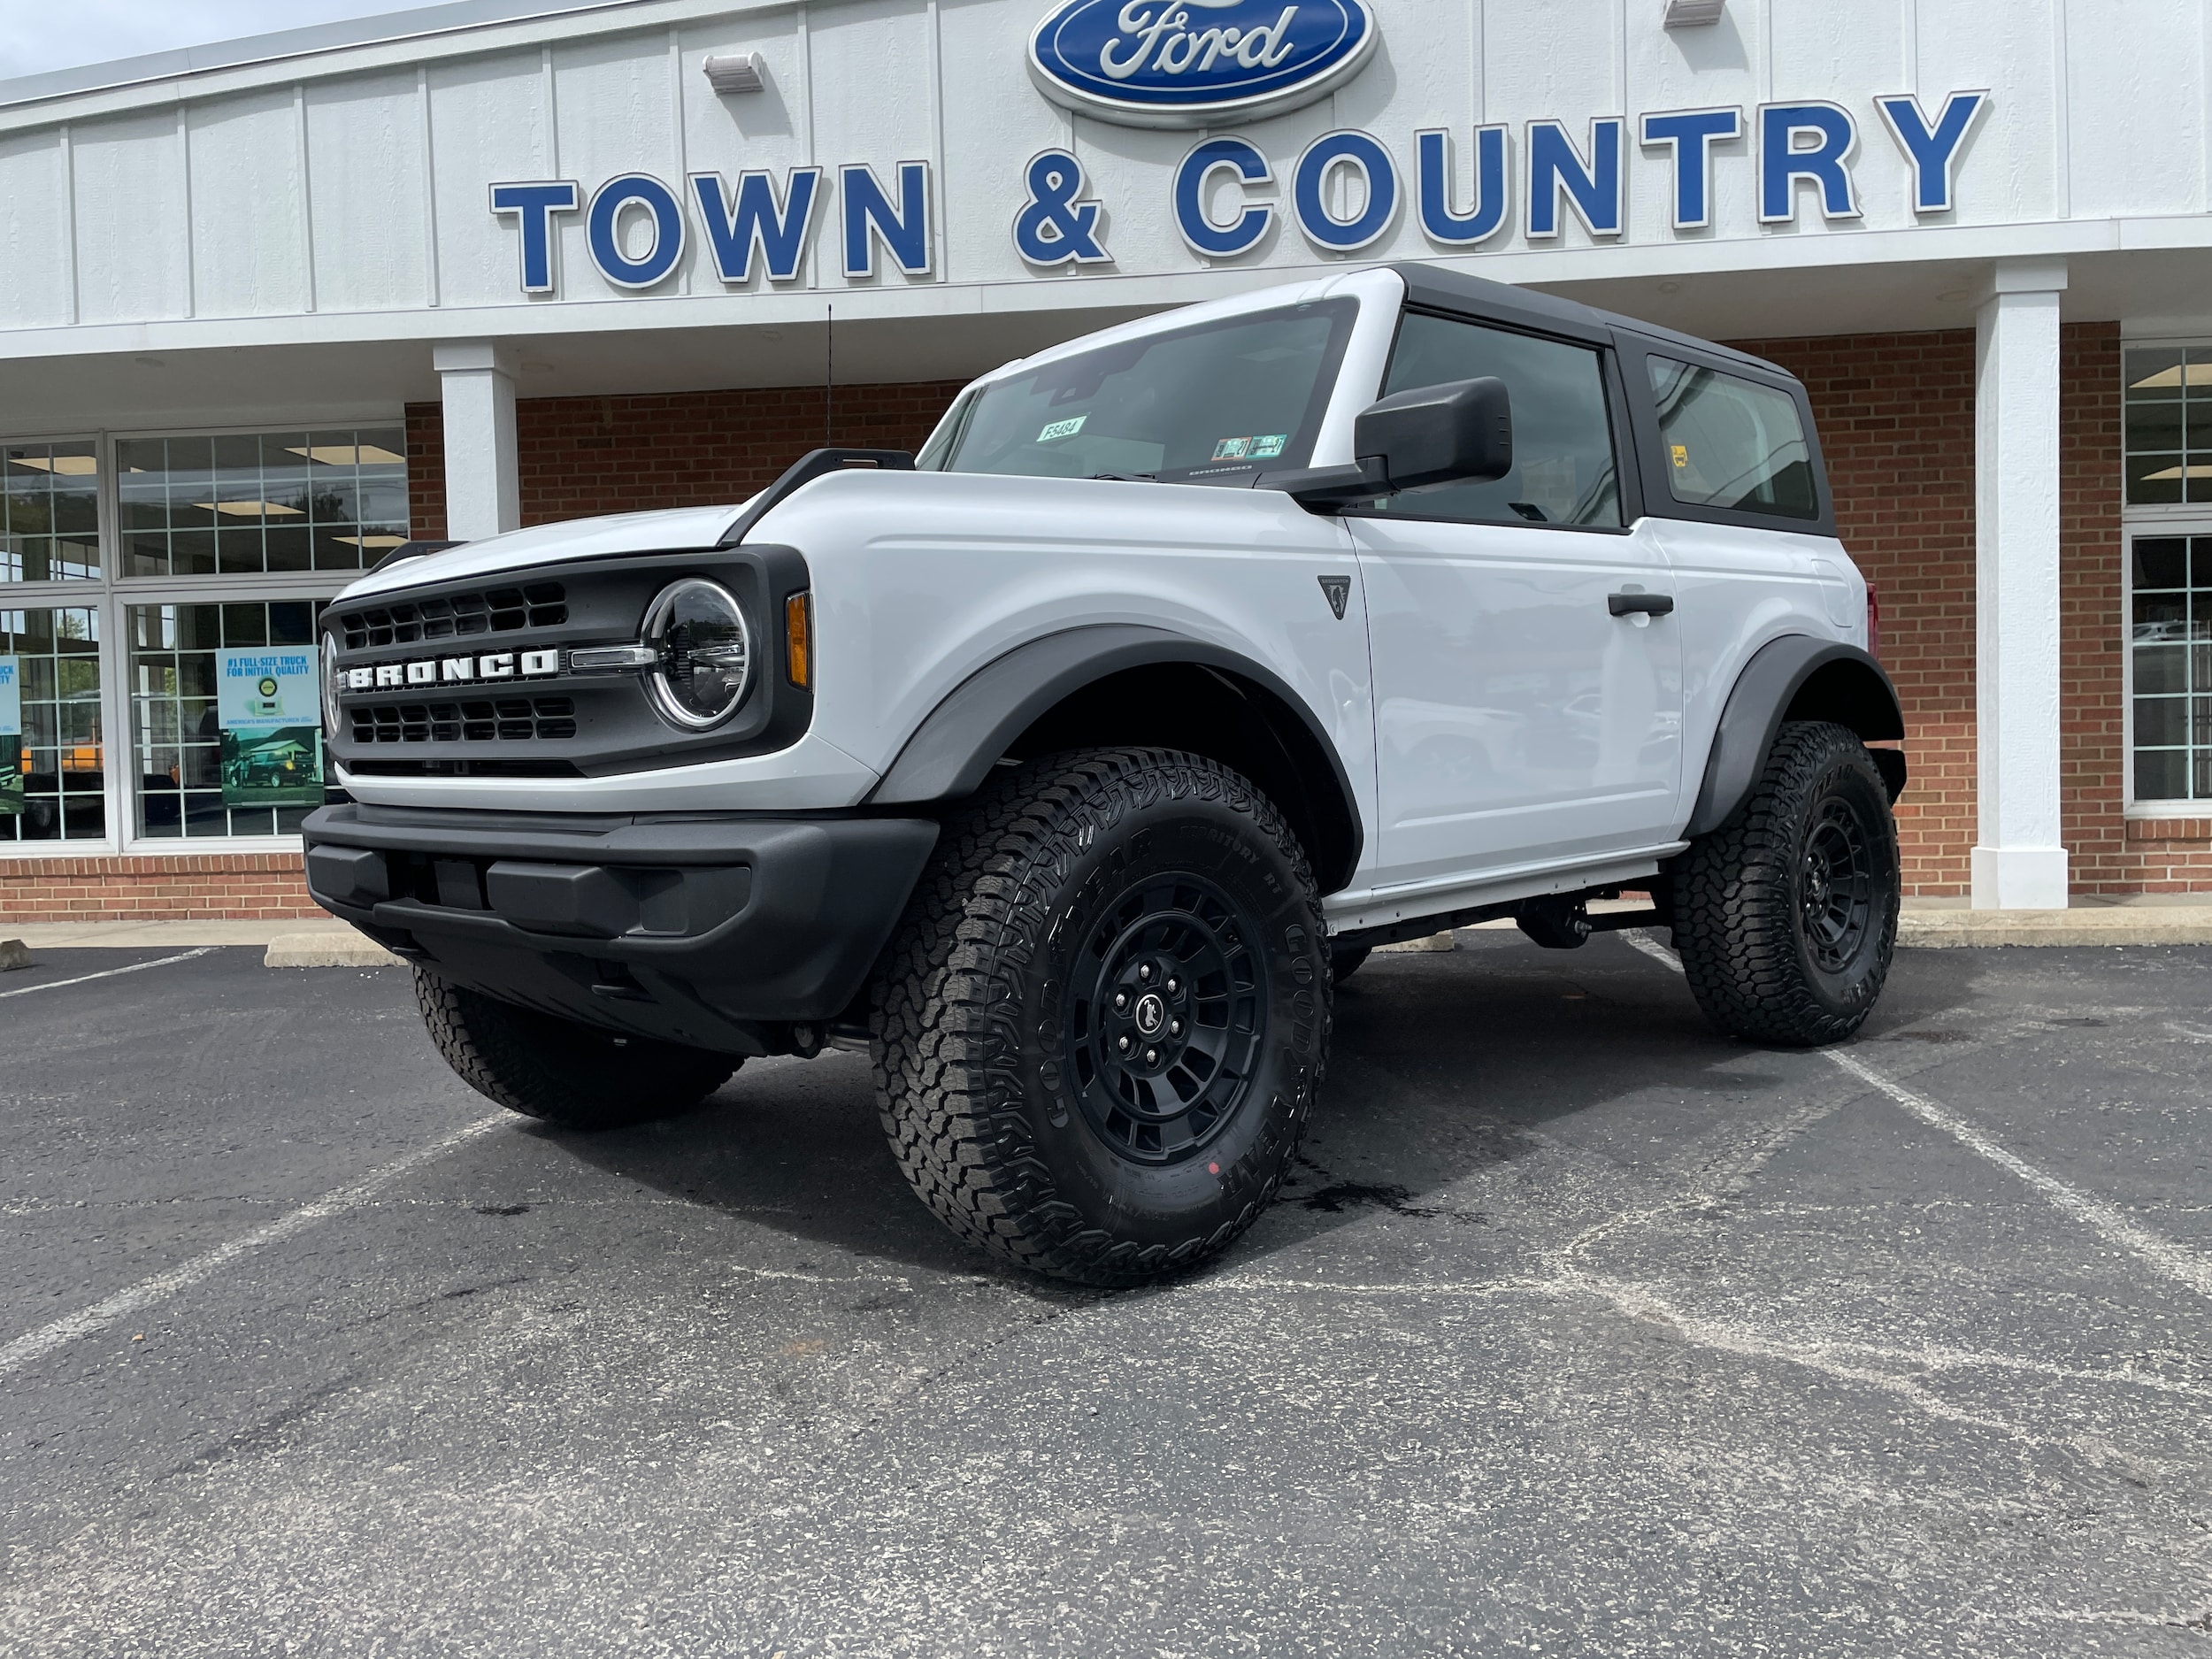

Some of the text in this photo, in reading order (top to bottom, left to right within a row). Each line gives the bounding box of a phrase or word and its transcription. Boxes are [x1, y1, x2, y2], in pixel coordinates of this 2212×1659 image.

[1100, 0, 1299, 80] Ford
[488, 89, 1991, 293] TOWN & COUNTRY
[227, 656, 307, 668] #1 FULL-SIZE TRUCK
[227, 665, 309, 677] FOR INITIAL QUALITY
[349, 649, 557, 688] BRONCO
